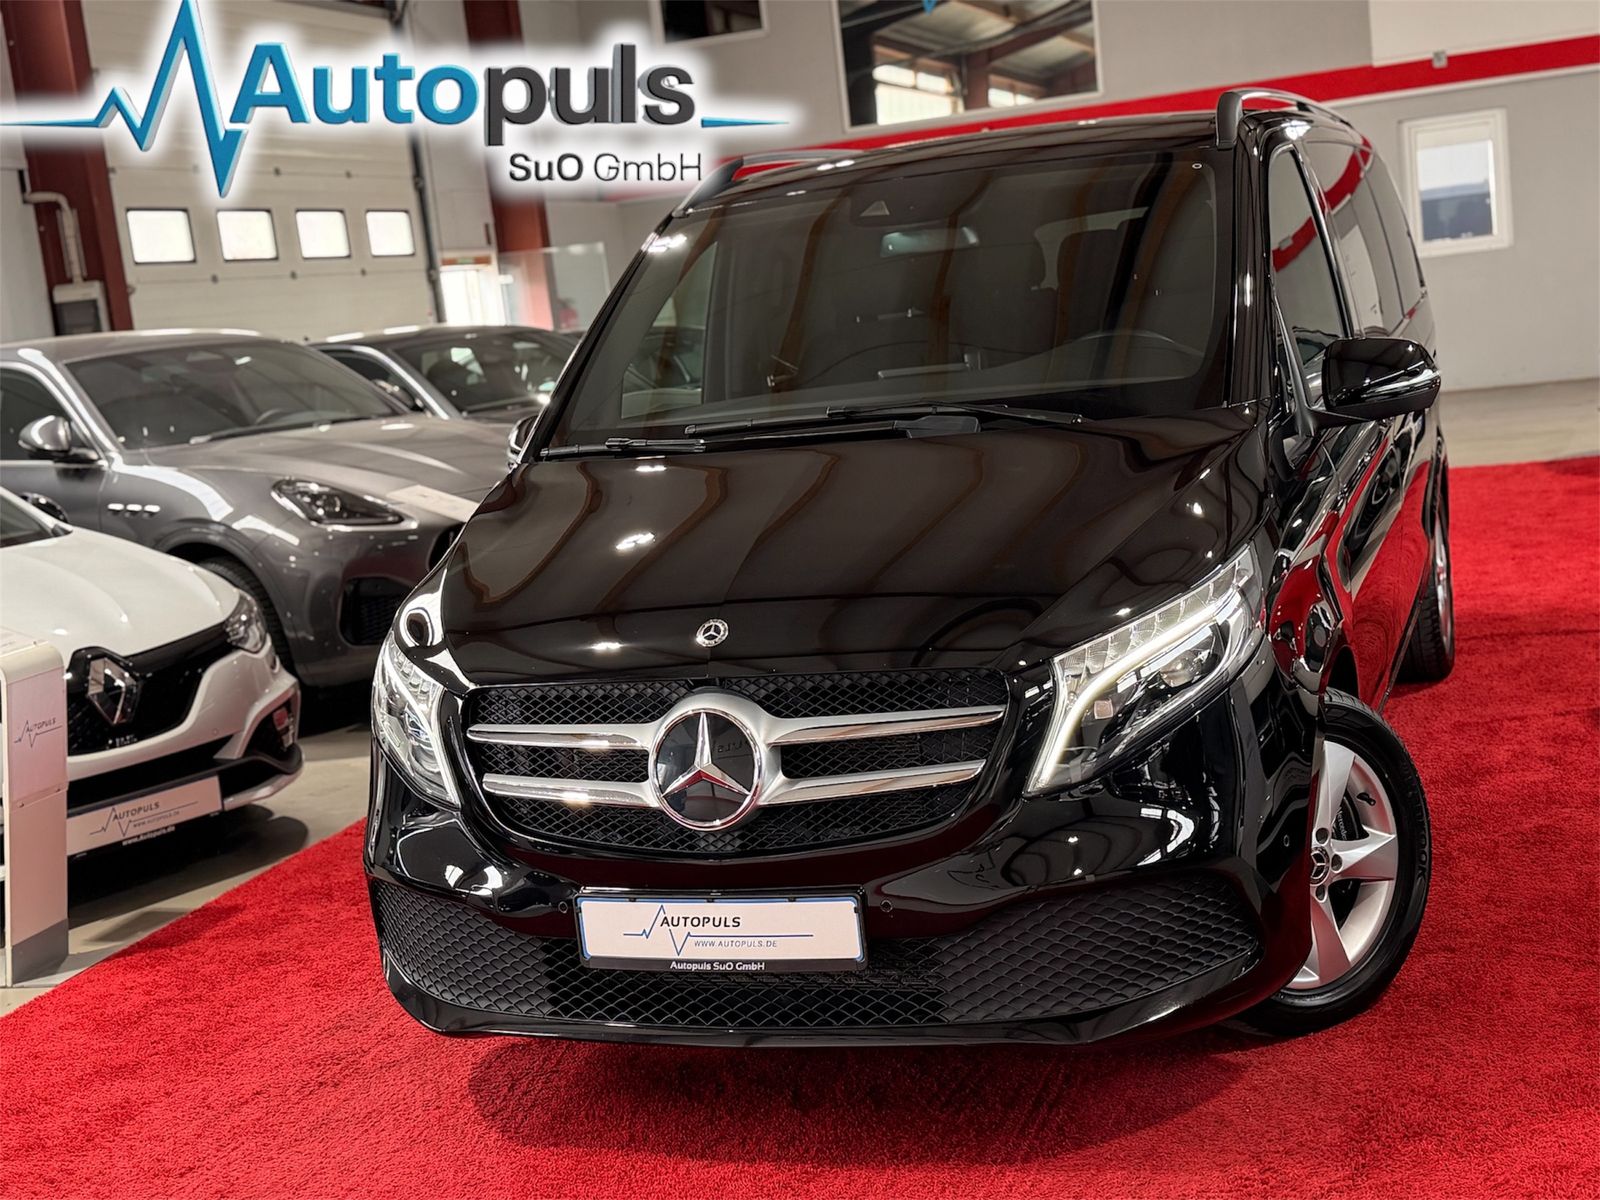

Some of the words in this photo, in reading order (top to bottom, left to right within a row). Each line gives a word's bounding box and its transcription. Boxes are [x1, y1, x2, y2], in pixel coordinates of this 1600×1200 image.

[112, 801, 160, 822] AUTOPULS
[660, 916, 741, 928] AUTOPULS
[694, 940, 777, 948] WWW.AUTOPULS.DE
[670, 961, 711, 971] Autopuls
[713, 962, 734, 970] SuO
[735, 962, 765, 970] GmbH
